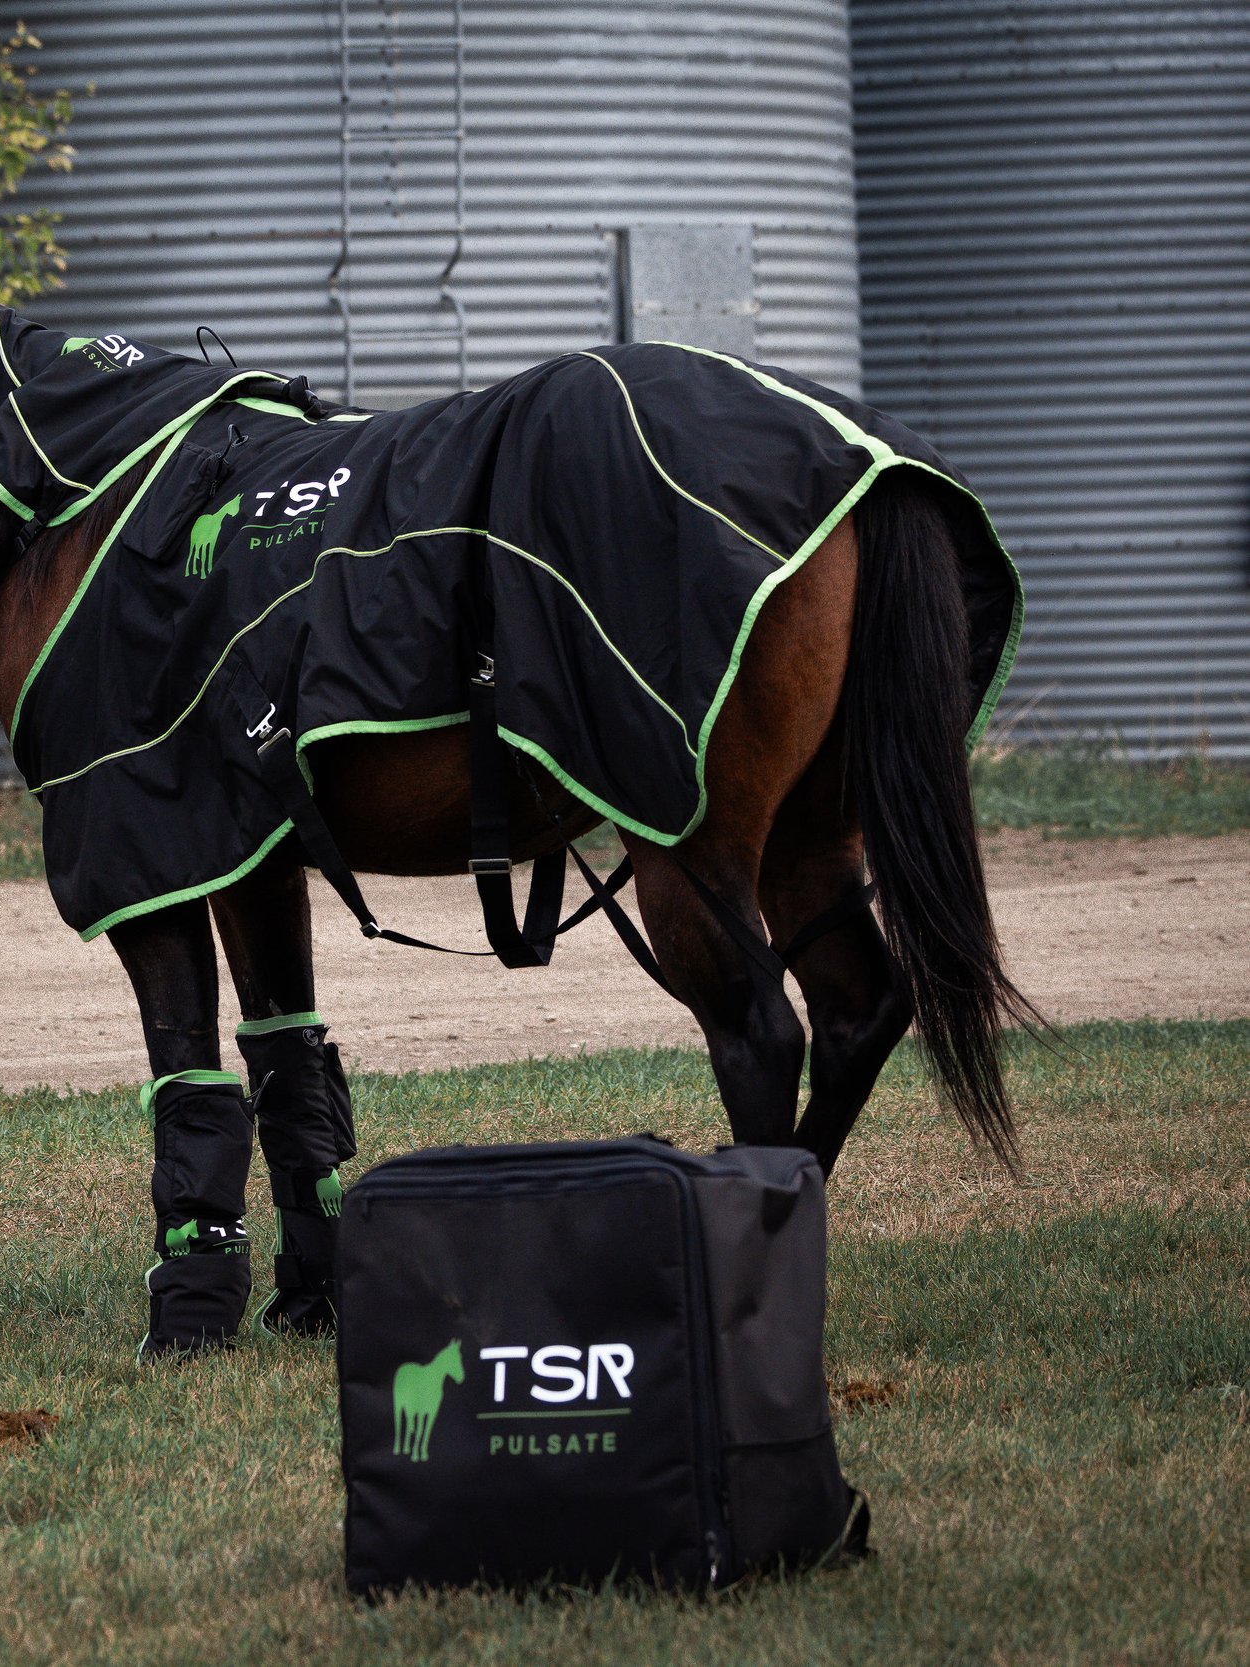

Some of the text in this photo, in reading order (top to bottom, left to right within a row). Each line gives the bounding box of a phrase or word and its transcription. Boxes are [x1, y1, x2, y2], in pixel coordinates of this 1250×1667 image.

[81, 347, 116, 373] LSAT
[97, 334, 145, 367] SR
[249, 519, 325, 550] PULSAT
[479, 1343, 635, 1402] TSR
[489, 1431, 618, 1456] PULSATE
